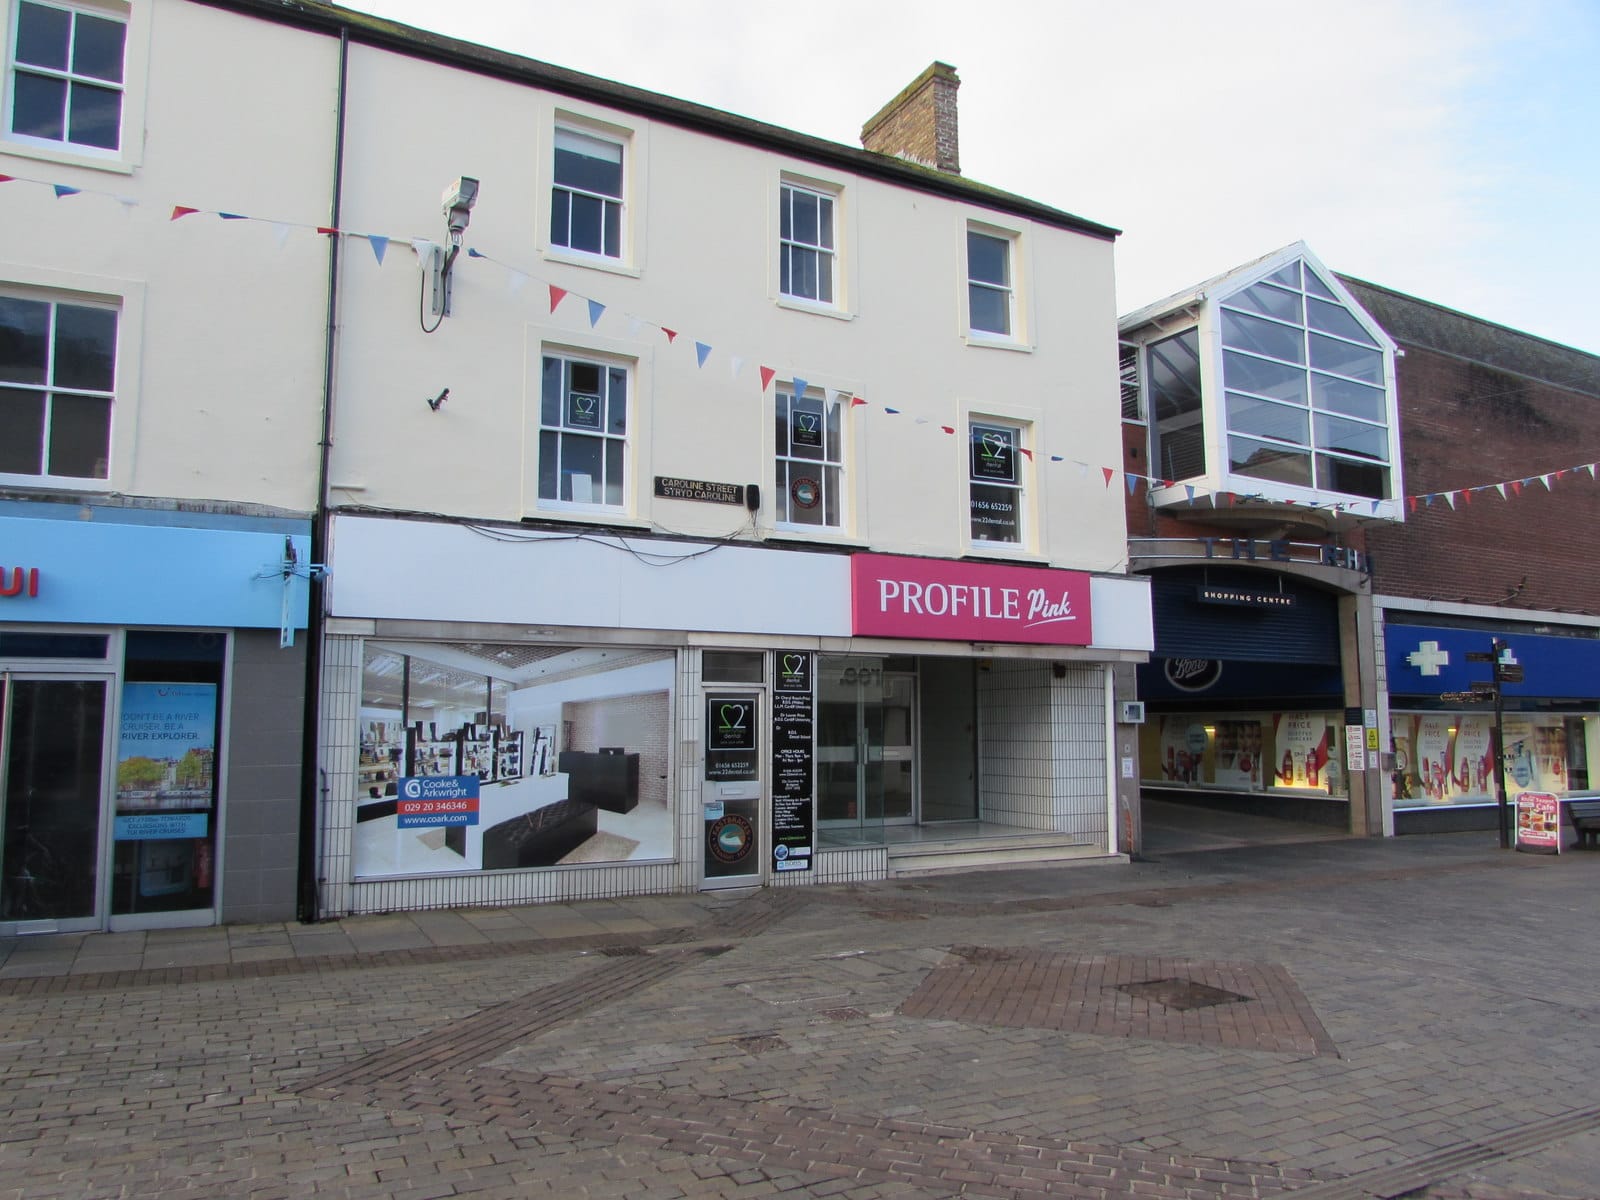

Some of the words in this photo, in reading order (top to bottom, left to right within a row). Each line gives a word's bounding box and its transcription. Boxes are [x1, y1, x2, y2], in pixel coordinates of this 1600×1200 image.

[661, 478, 704, 491] CAROLINE
[705, 482, 738, 494] STREET
[664, 486, 693, 498] STRYD
[694, 490, 736, 503] CAROLINE
[971, 500, 990, 510] 01656
[990, 502, 1013, 512] 652259
[1199, 537, 1290, 562] THE
[876, 578, 1021, 621] PROFILE
[1026, 587, 1072, 621] Pink
[1203, 591, 1252, 602] SHOPPING
[1256, 596, 1292, 606] CENTRE
[175, 712, 200, 721] RIVER
[164, 722, 177, 731] BE
[1287, 721, 1311, 729] PRICE
[121, 732, 149, 740] RIVER
[422, 787, 467, 799] Arkwright
[404, 803, 421, 812] 029
[423, 803, 434, 811] 20
[435, 801, 468, 811] 346346
[404, 814, 468, 825] www.coark.com
